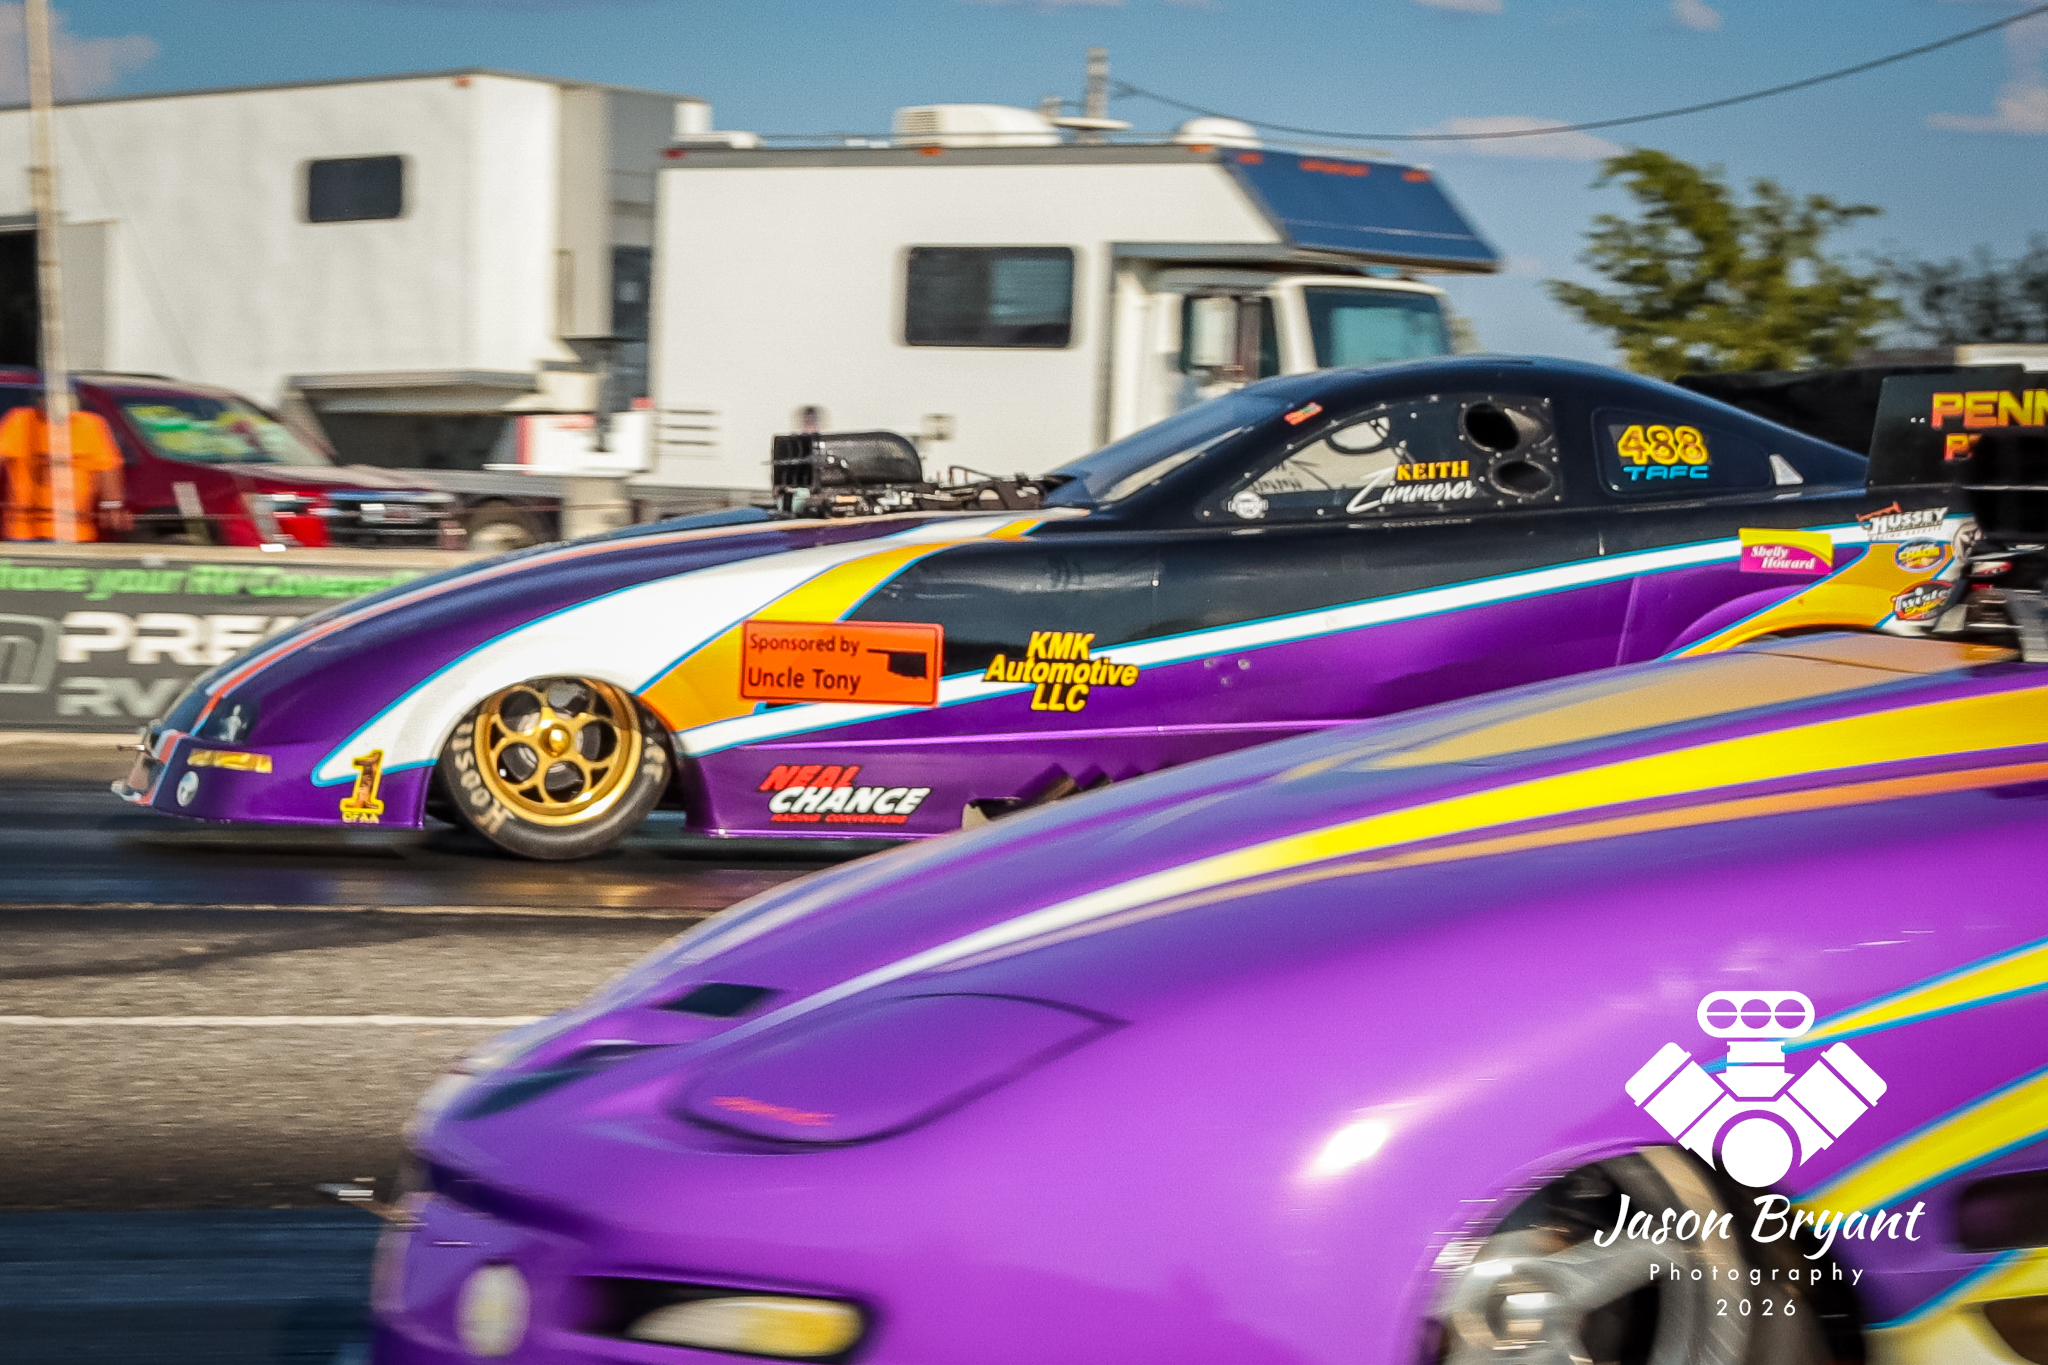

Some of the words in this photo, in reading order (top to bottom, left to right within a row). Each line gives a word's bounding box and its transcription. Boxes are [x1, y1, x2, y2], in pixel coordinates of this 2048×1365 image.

[1618, 425, 1709, 465] 488
[1397, 461, 1469, 480] KEITH
[1623, 465, 1709, 481] TAFC
[1346, 465, 1477, 514] Zimmerer
[1869, 506, 1949, 534] HUSSEY
[1761, 558, 1816, 570] Howard
[750, 633, 836, 652] Sponsored
[840, 636, 861, 656] by
[1027, 631, 1096, 660] KMK
[748, 667, 805, 689] Uncle
[812, 668, 861, 695] Tony
[984, 653, 1139, 686] Automotive
[56, 677, 184, 717] RV
[1030, 683, 1091, 712] LLC
[340, 749, 384, 814] 1
[759, 765, 860, 791] NEAL
[768, 786, 932, 814] CHANCE
